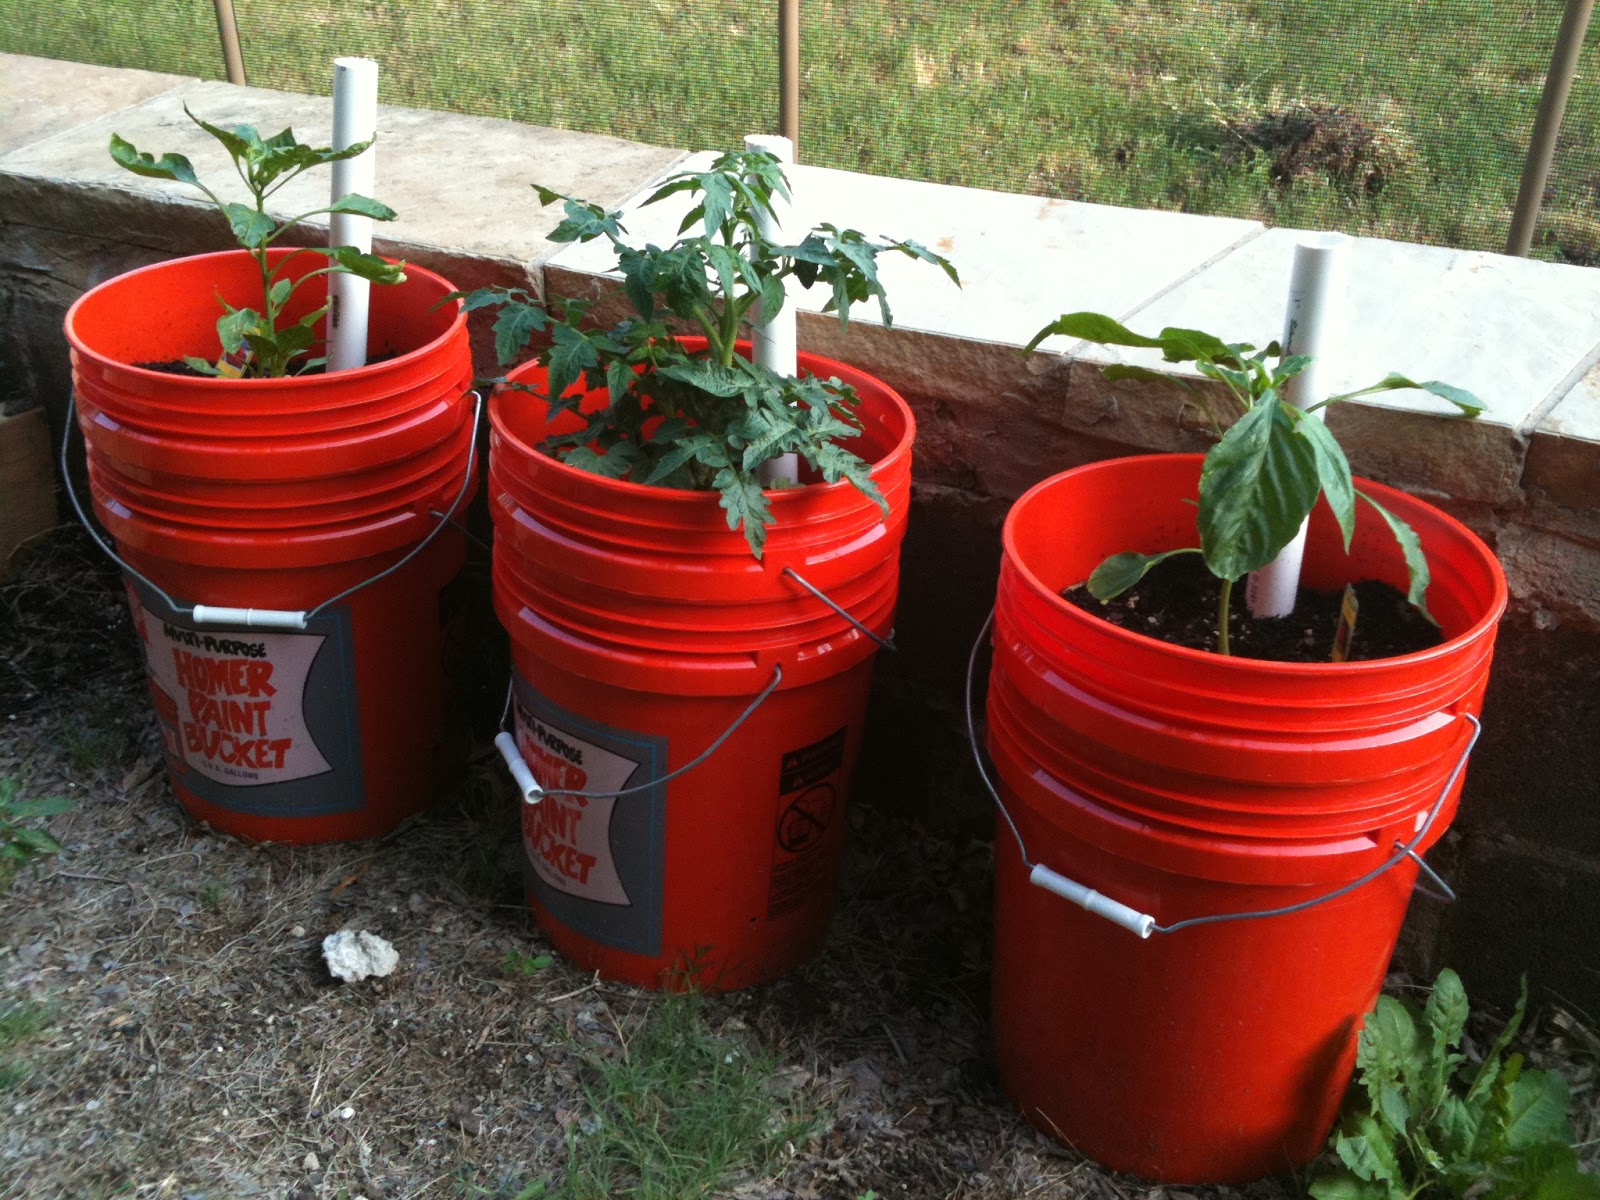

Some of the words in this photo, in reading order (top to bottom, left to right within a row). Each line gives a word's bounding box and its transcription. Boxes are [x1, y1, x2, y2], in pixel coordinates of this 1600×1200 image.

[173, 648, 277, 697] HOMER
[188, 688, 271, 736] PAINT
[183, 722, 292, 769] BUCKET
